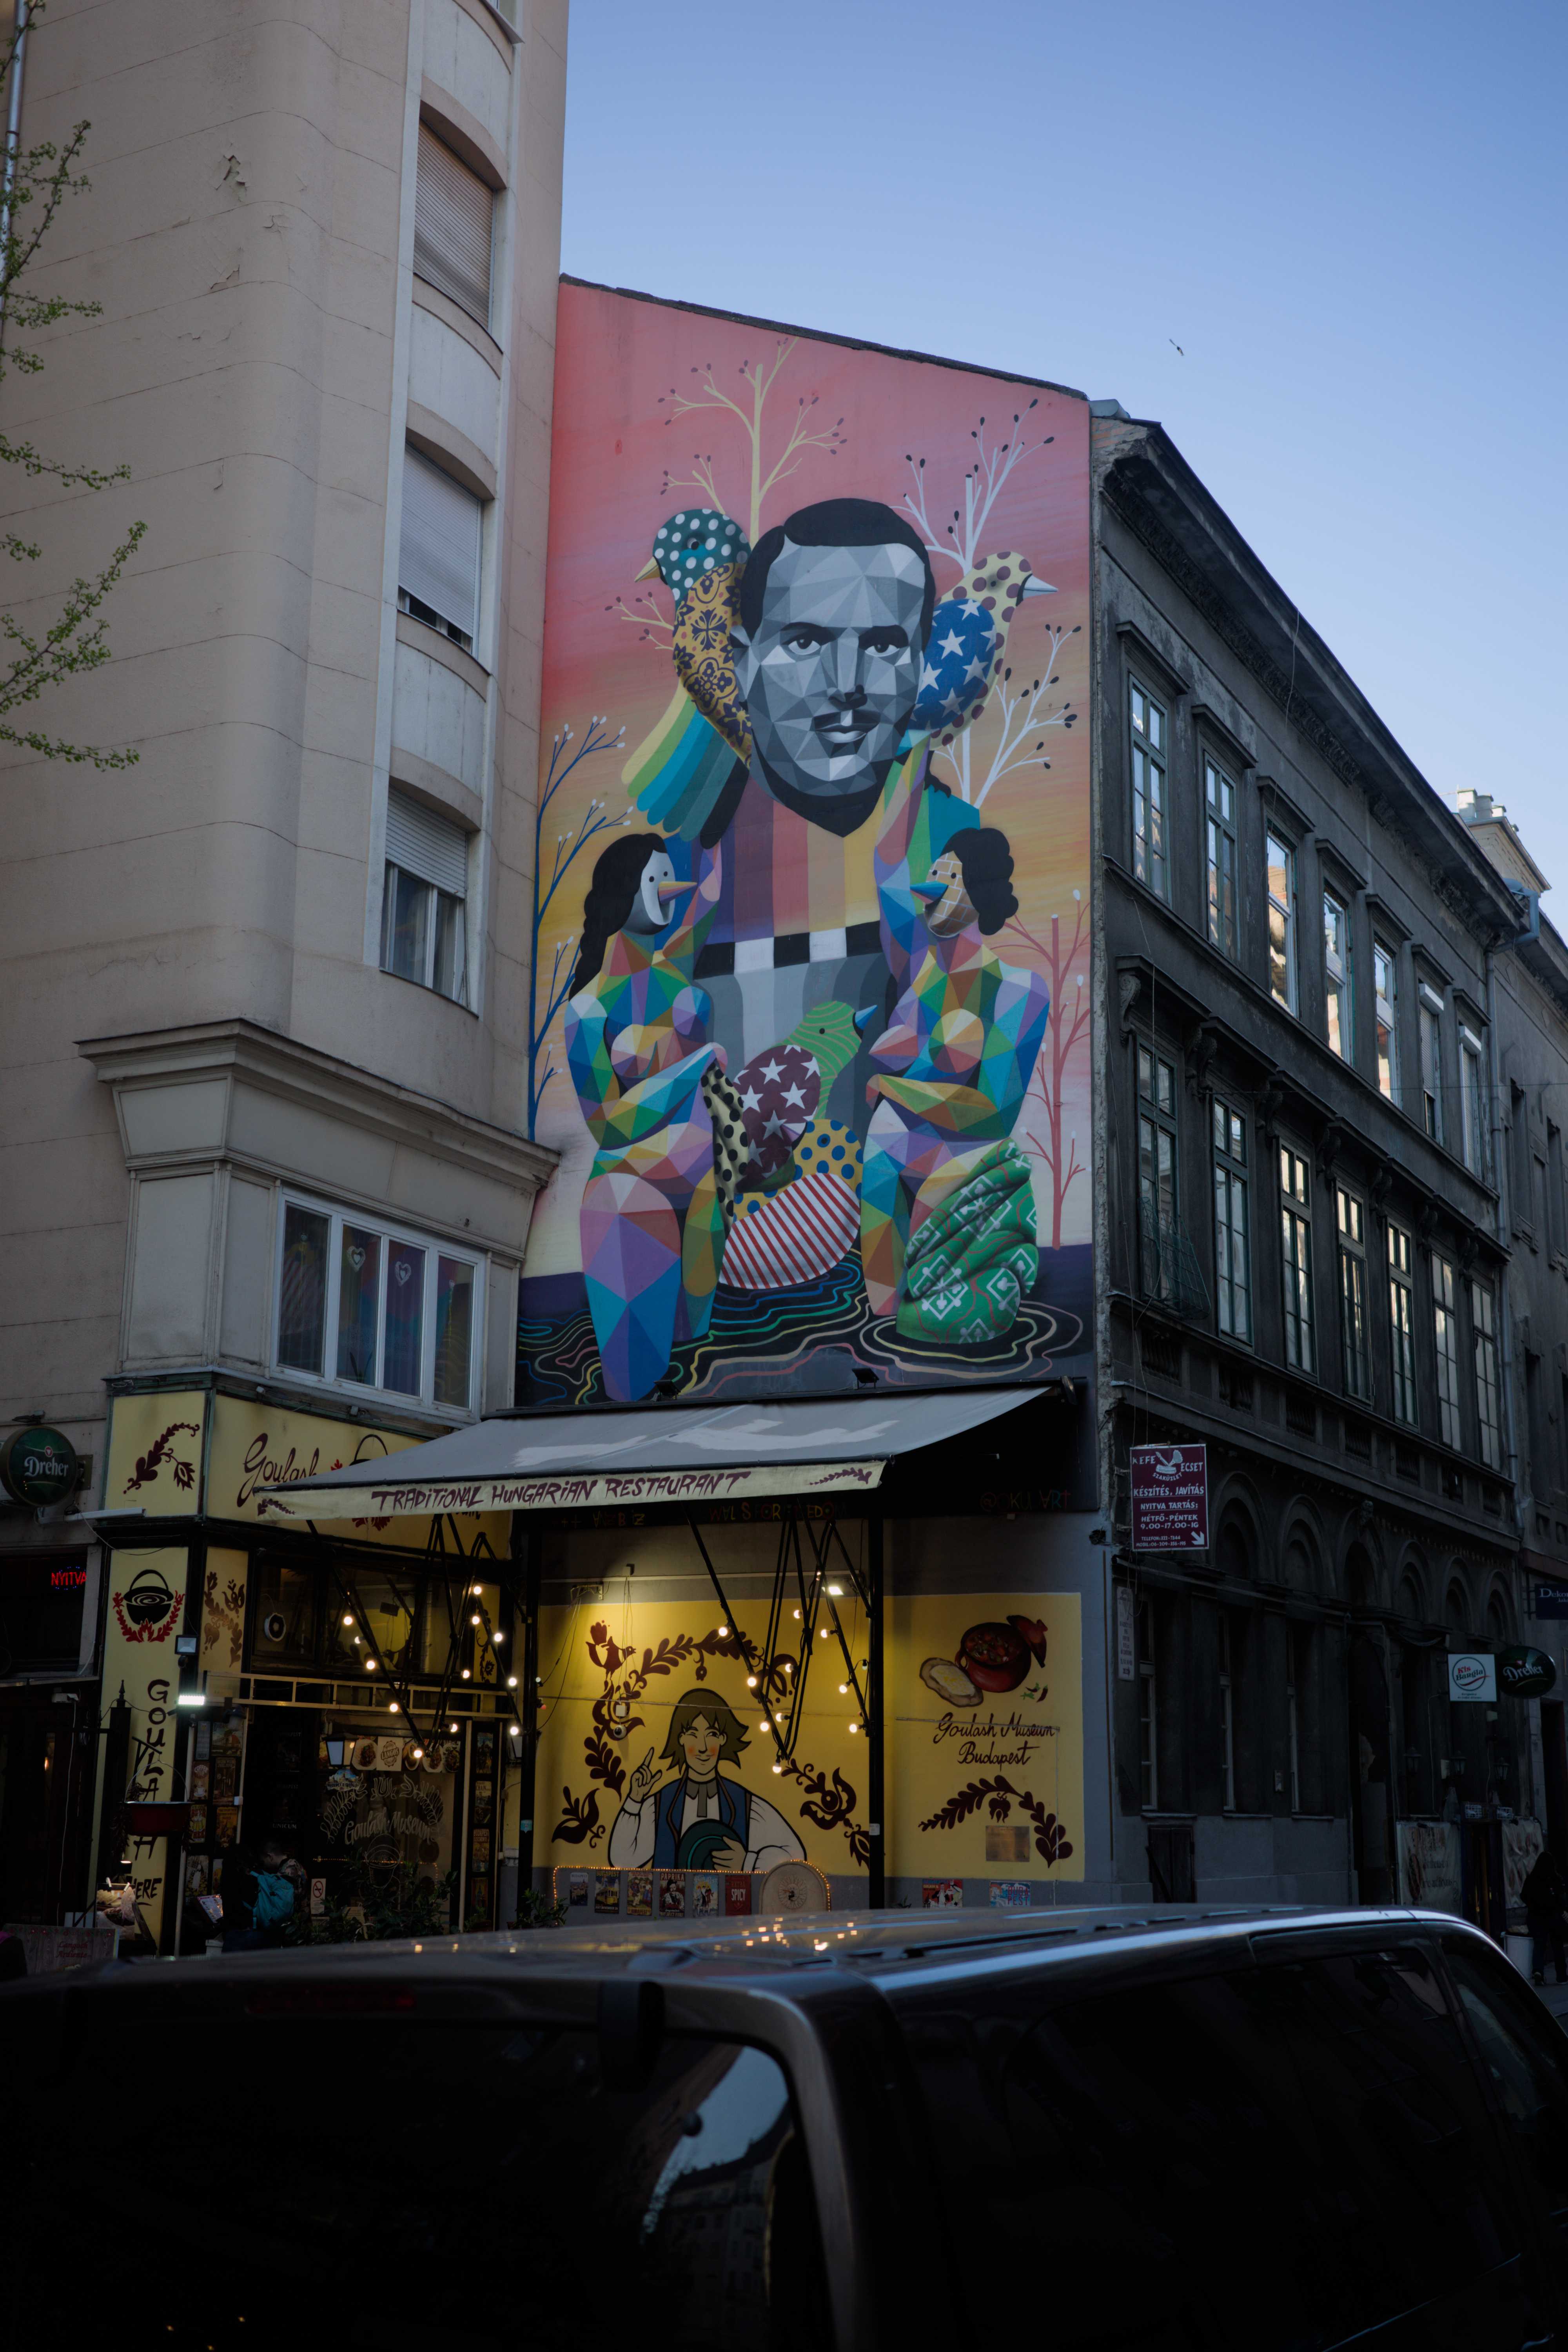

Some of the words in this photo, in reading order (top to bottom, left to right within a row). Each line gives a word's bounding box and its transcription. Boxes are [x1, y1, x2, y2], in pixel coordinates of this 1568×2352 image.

[1132, 1455, 1156, 1465] KEFE
[24, 1456, 69, 1477] Dreher
[1180, 1462, 1203, 1472] ECSET
[605, 1471, 751, 1499] RESTAURANT
[1175, 1483, 1204, 1495] JAVÍTÁS
[1168, 1499, 1198, 1509] TARTÁS:
[1503, 1665, 1543, 1682] Dreher
[933, 1712, 997, 1744] Goulash
[1001, 1711, 1056, 1737] Museum
[957, 1740, 1040, 1771] Budapest
[134, 1679, 170, 1860] GOULAH
[731, 1889, 746, 1901] SPICY
[1007, 1886, 1029, 1896] BUDA
[1007, 1896, 1029, 1906] PEST
